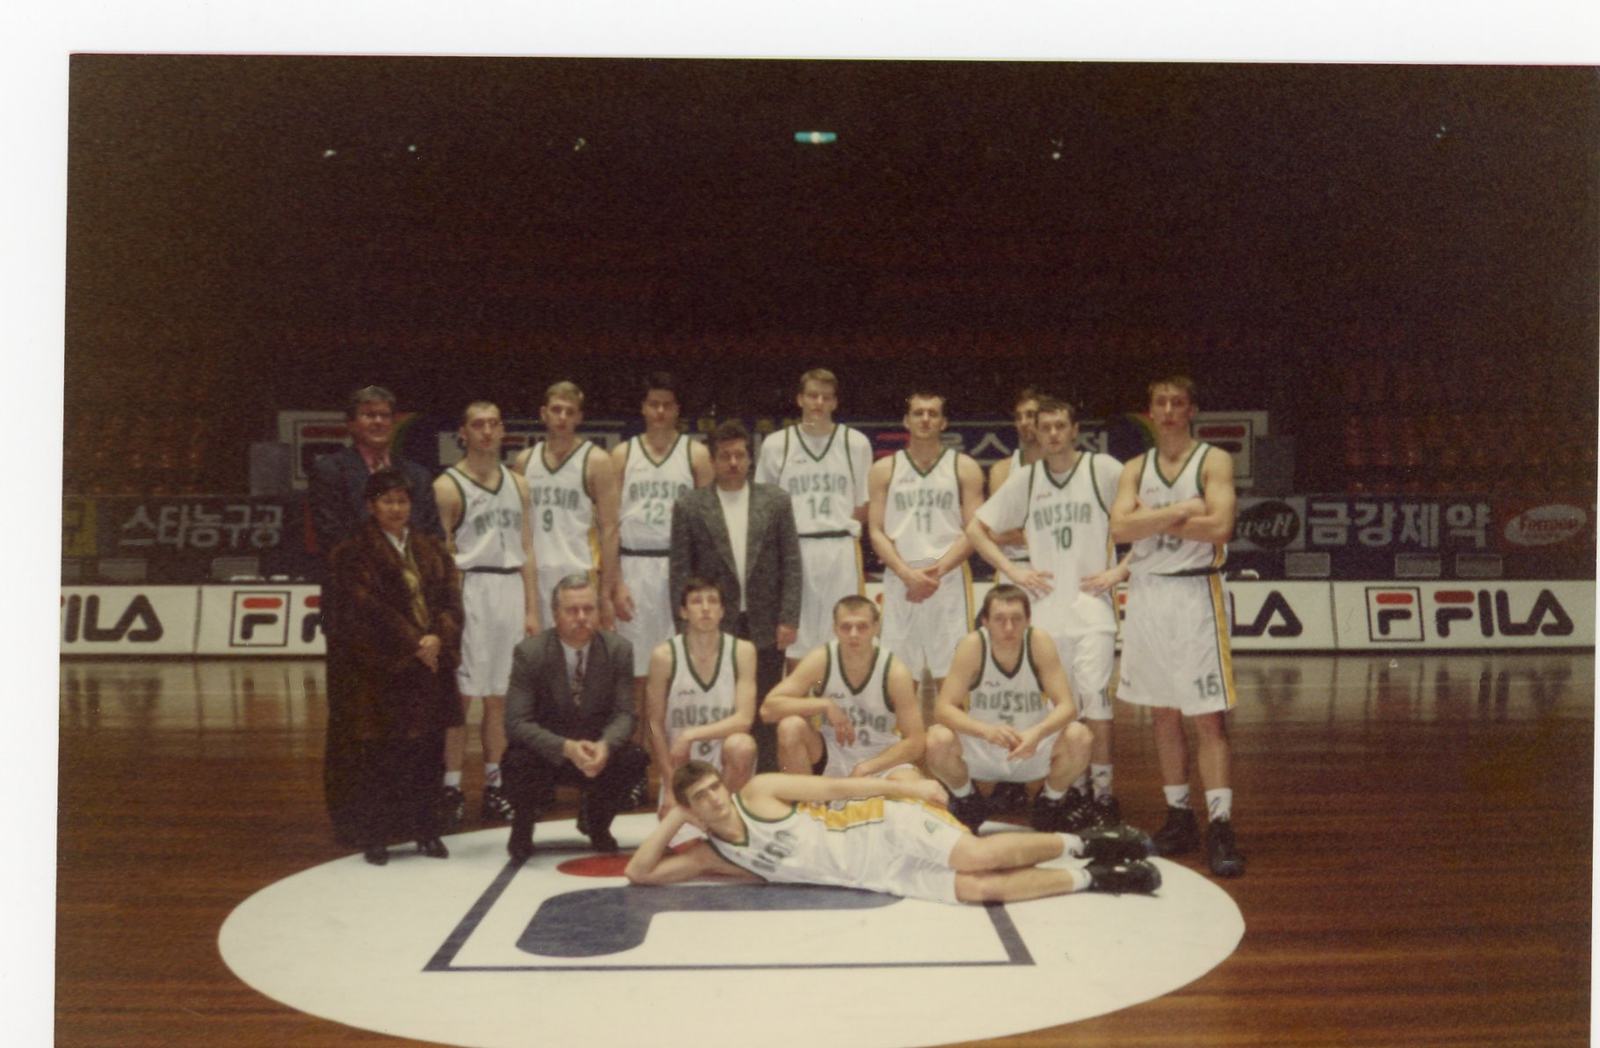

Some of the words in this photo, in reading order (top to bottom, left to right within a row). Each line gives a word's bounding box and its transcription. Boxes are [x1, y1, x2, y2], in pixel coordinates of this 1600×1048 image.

[788, 474, 848, 496] RUSSIA
[530, 487, 579, 510] USSIA
[808, 497, 831, 518] 14
[895, 490, 954, 511] RUSSIA
[542, 509, 554, 532] 9
[643, 499, 665, 527] 12
[914, 510, 931, 533] 11
[1033, 502, 1092, 531] RUSSIA
[1308, 501, 1491, 548] 금강제약
[118, 504, 283, 548] 스타농구공
[1052, 526, 1072, 549] 10
[61, 594, 164, 643] ILA
[1434, 588, 1574, 637] FILA
[975, 690, 1042, 713] RUSSIA
